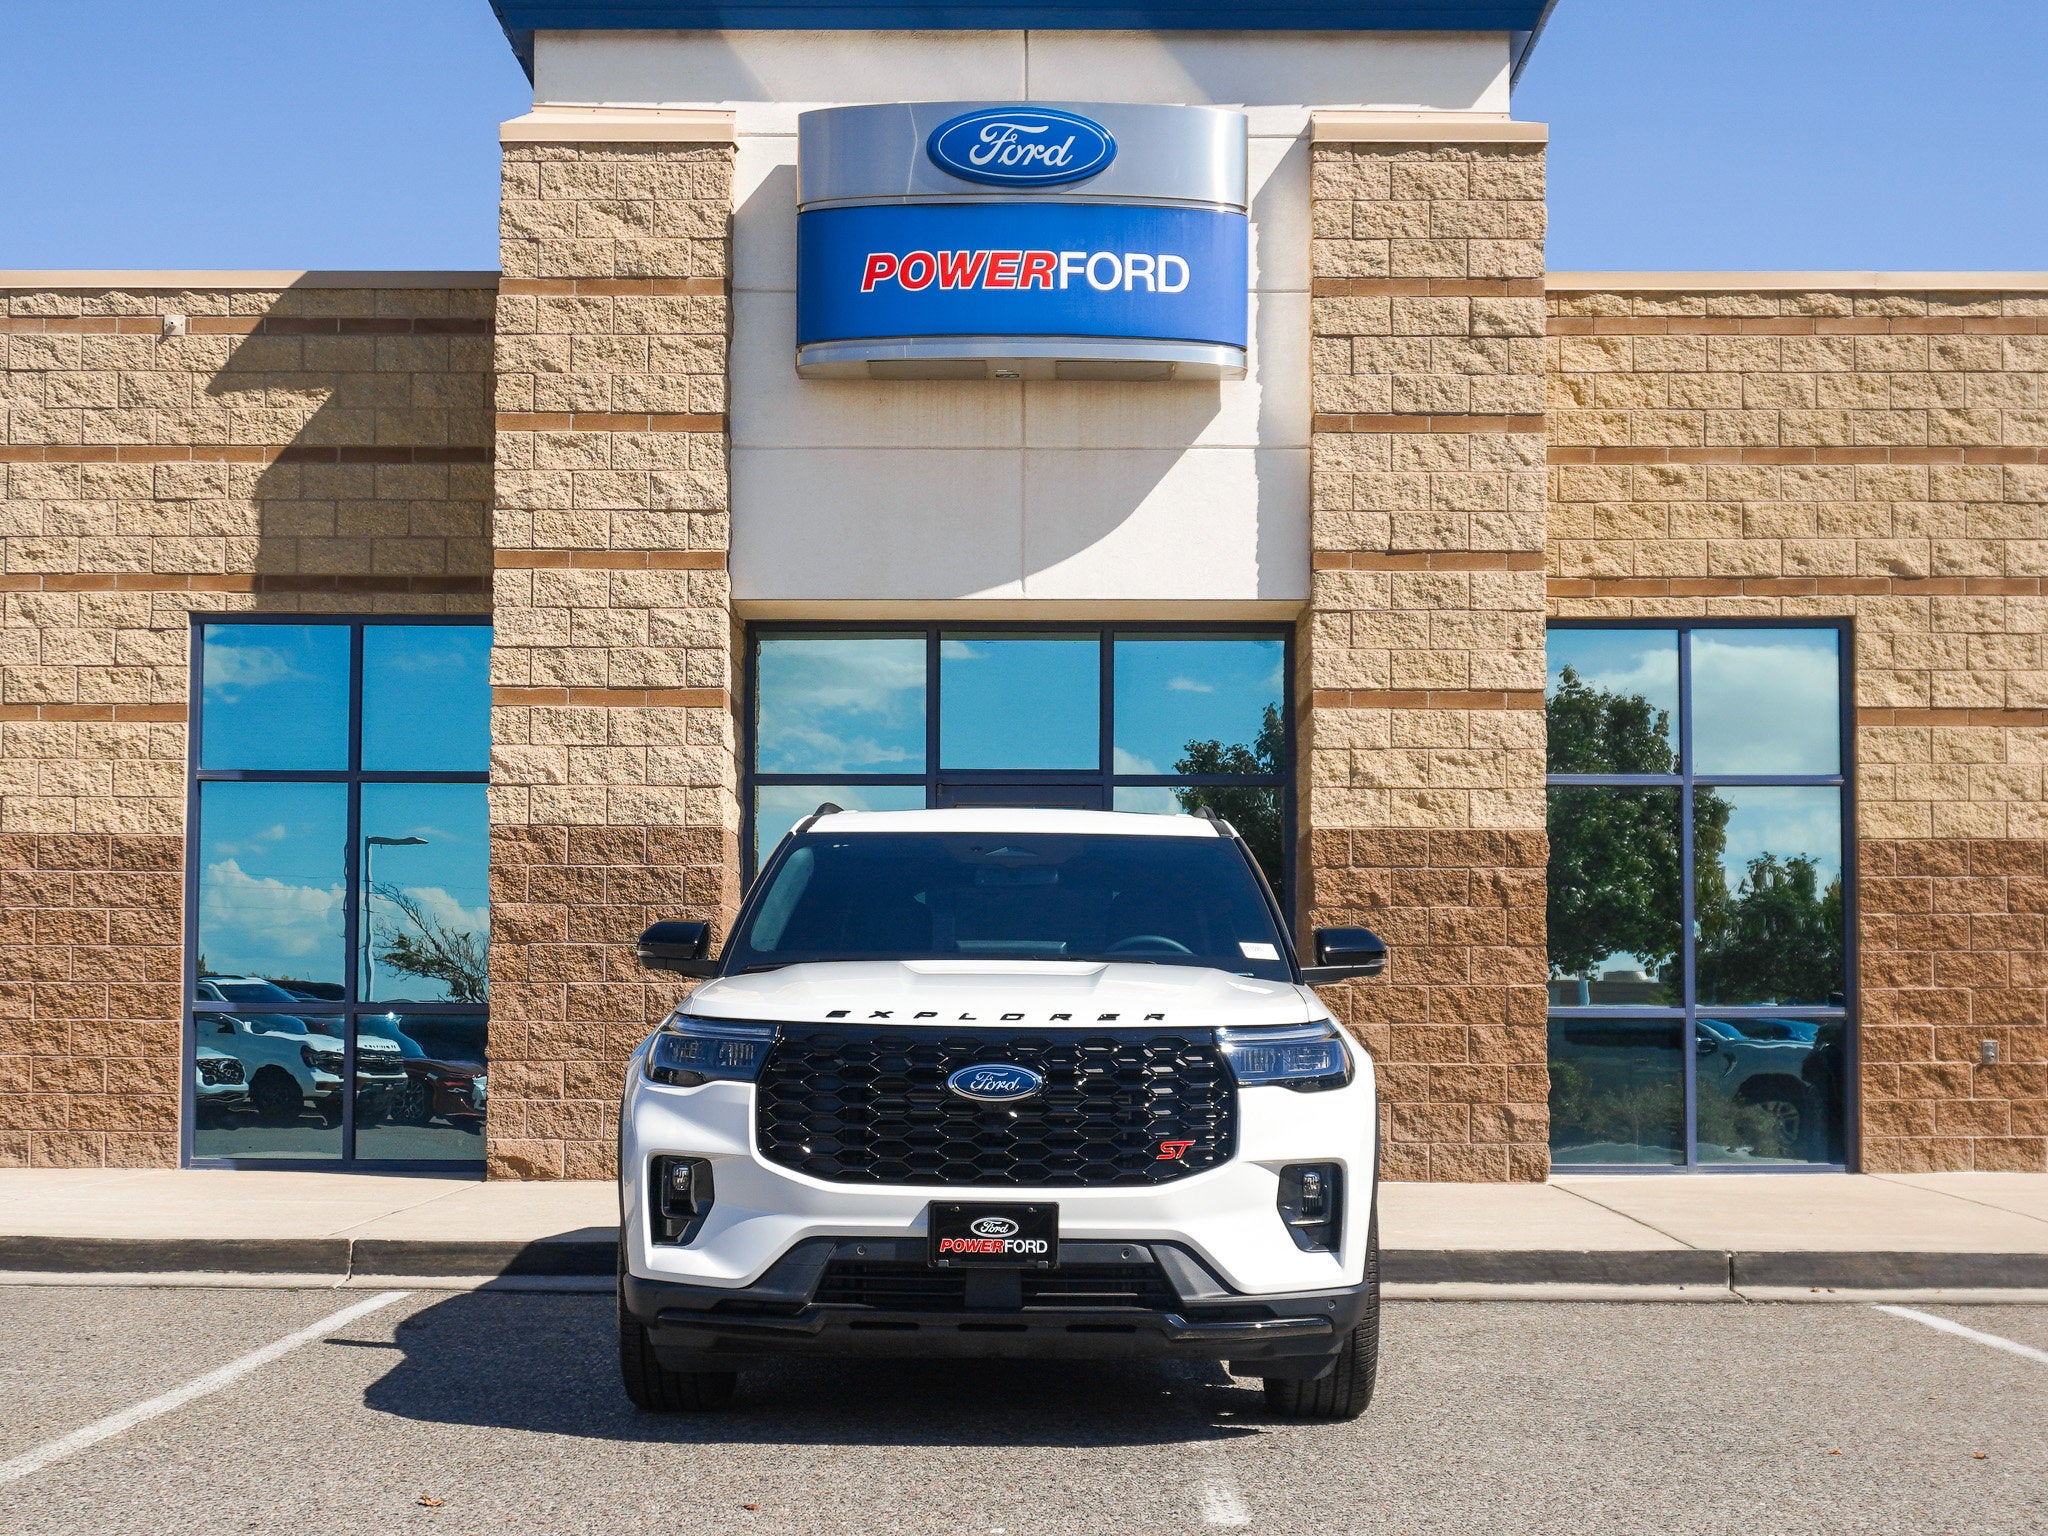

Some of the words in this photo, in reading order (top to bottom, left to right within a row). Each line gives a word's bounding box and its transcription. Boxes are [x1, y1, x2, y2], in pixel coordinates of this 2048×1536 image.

[969, 123, 1076, 167] Ford
[860, 250, 1190, 293] POWERFORD
[825, 1010, 1166, 1021] EXPLORER
[970, 1071, 1020, 1092] Ford
[1156, 1140, 1196, 1160] ST
[980, 1220, 1009, 1234] Ford
[940, 1238, 1048, 1253] POWERFORD
